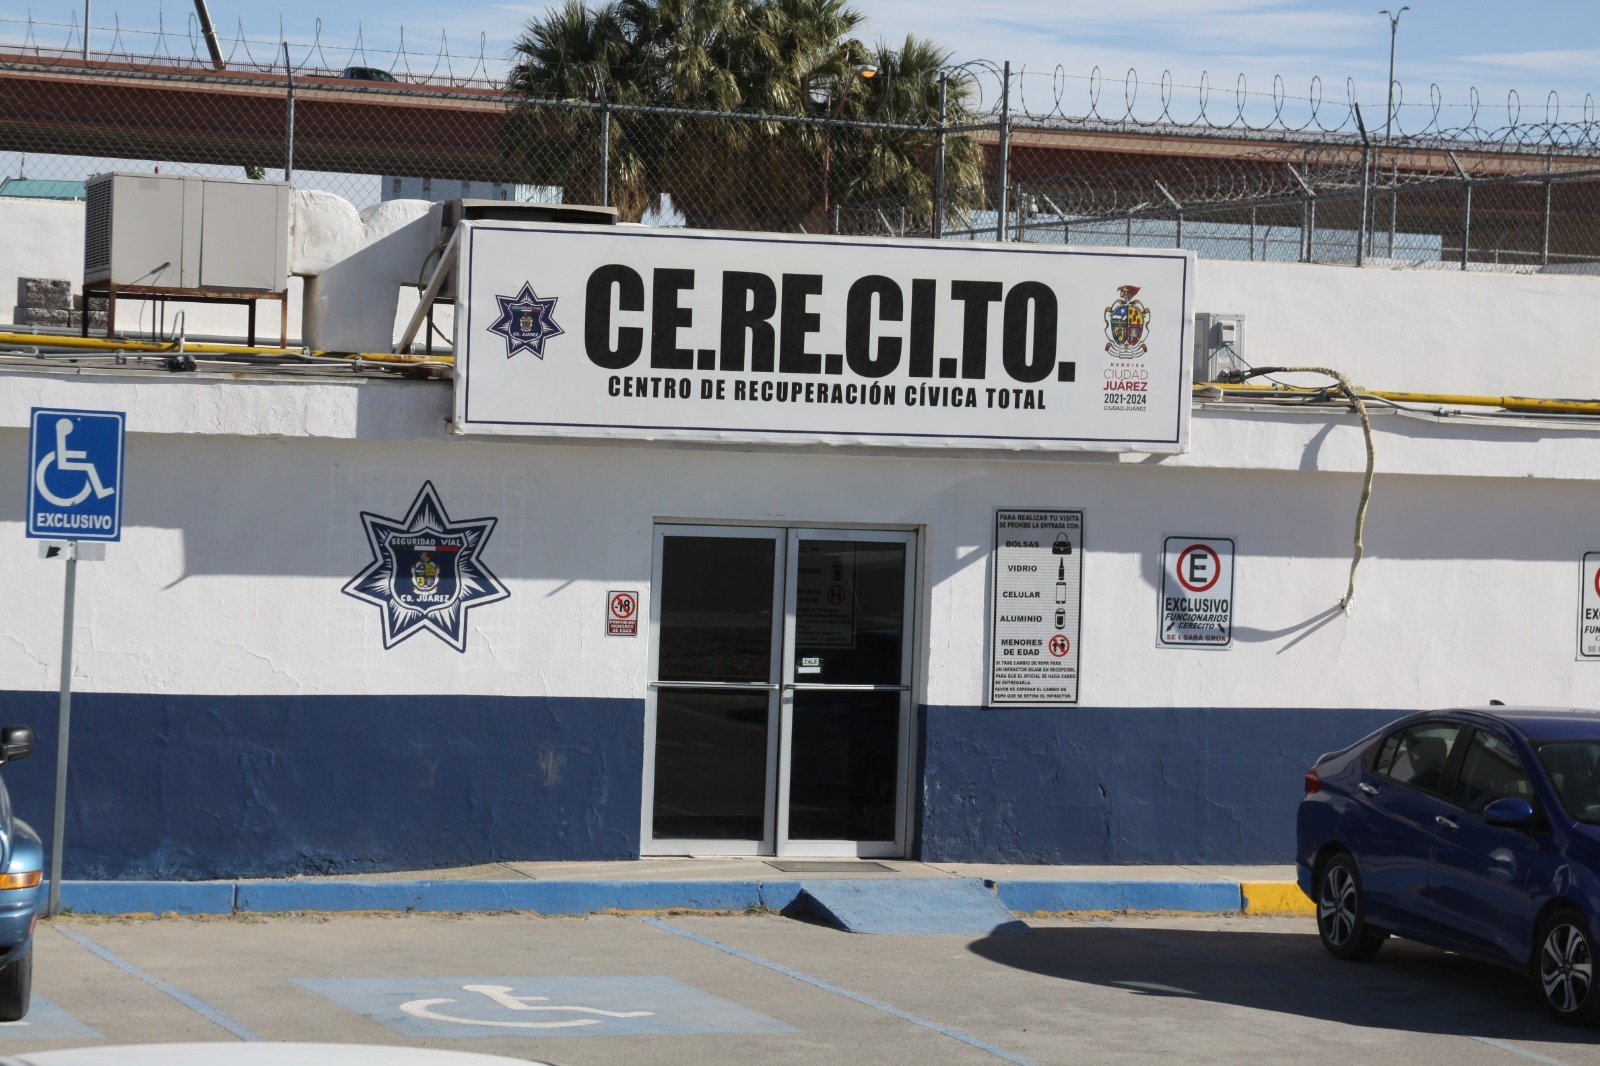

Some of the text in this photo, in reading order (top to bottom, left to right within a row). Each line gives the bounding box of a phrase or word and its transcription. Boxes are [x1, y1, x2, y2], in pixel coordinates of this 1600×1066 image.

[584, 264, 1076, 383] CE.RE.CI.TO.
[1104, 368, 1148, 380] CIUDAD
[1103, 379, 1148, 391] JUÁREZ
[608, 376, 1046, 410] CENTRO DE RECUPERACIÓN CÍVICA TOTAL
[1104, 393, 1146, 404] 2021-2024
[37, 512, 112, 529] EXCLUSIVO
[1189, 554, 1207, 582] E
[417, 594, 449, 602] JUÁREZ
[1165, 597, 1228, 613] EXCLUSIVO
[1165, 613, 1228, 622] FUNCIONARIOS
